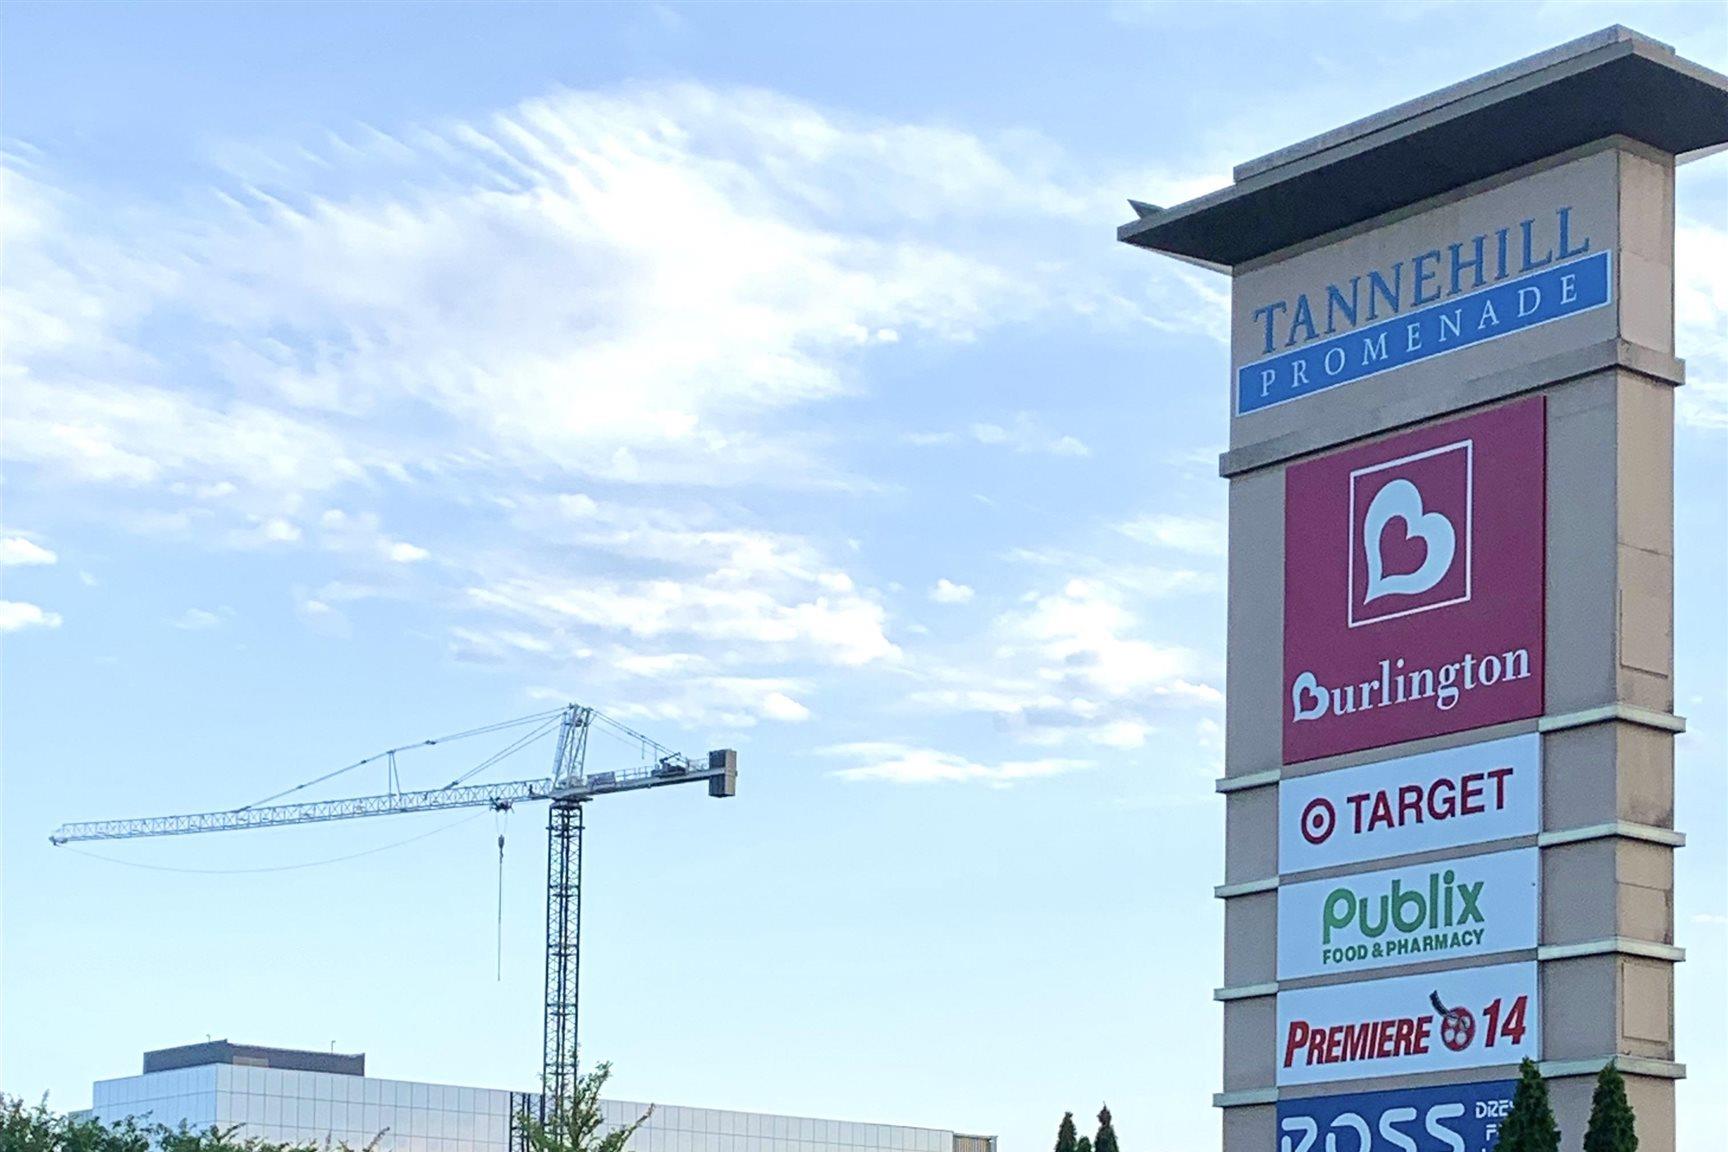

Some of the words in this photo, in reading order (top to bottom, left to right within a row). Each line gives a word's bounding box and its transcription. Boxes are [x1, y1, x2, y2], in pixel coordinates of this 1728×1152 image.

[1253, 206, 1590, 355] TANNEHILL
[1260, 273, 1578, 397] PROMENADE
[1292, 647, 1531, 722] Burlington
[1347, 768, 1514, 834] TARGET
[1323, 869, 1485, 944] Publix
[1323, 944, 1367, 965] FOOD
[1371, 943, 1383, 958] &
[1386, 928, 1485, 957] PHARMACY
[1284, 1015, 1432, 1068] PREMIERE
[1484, 995, 1528, 1048] 14
[1475, 1100, 1514, 1118] DRE
